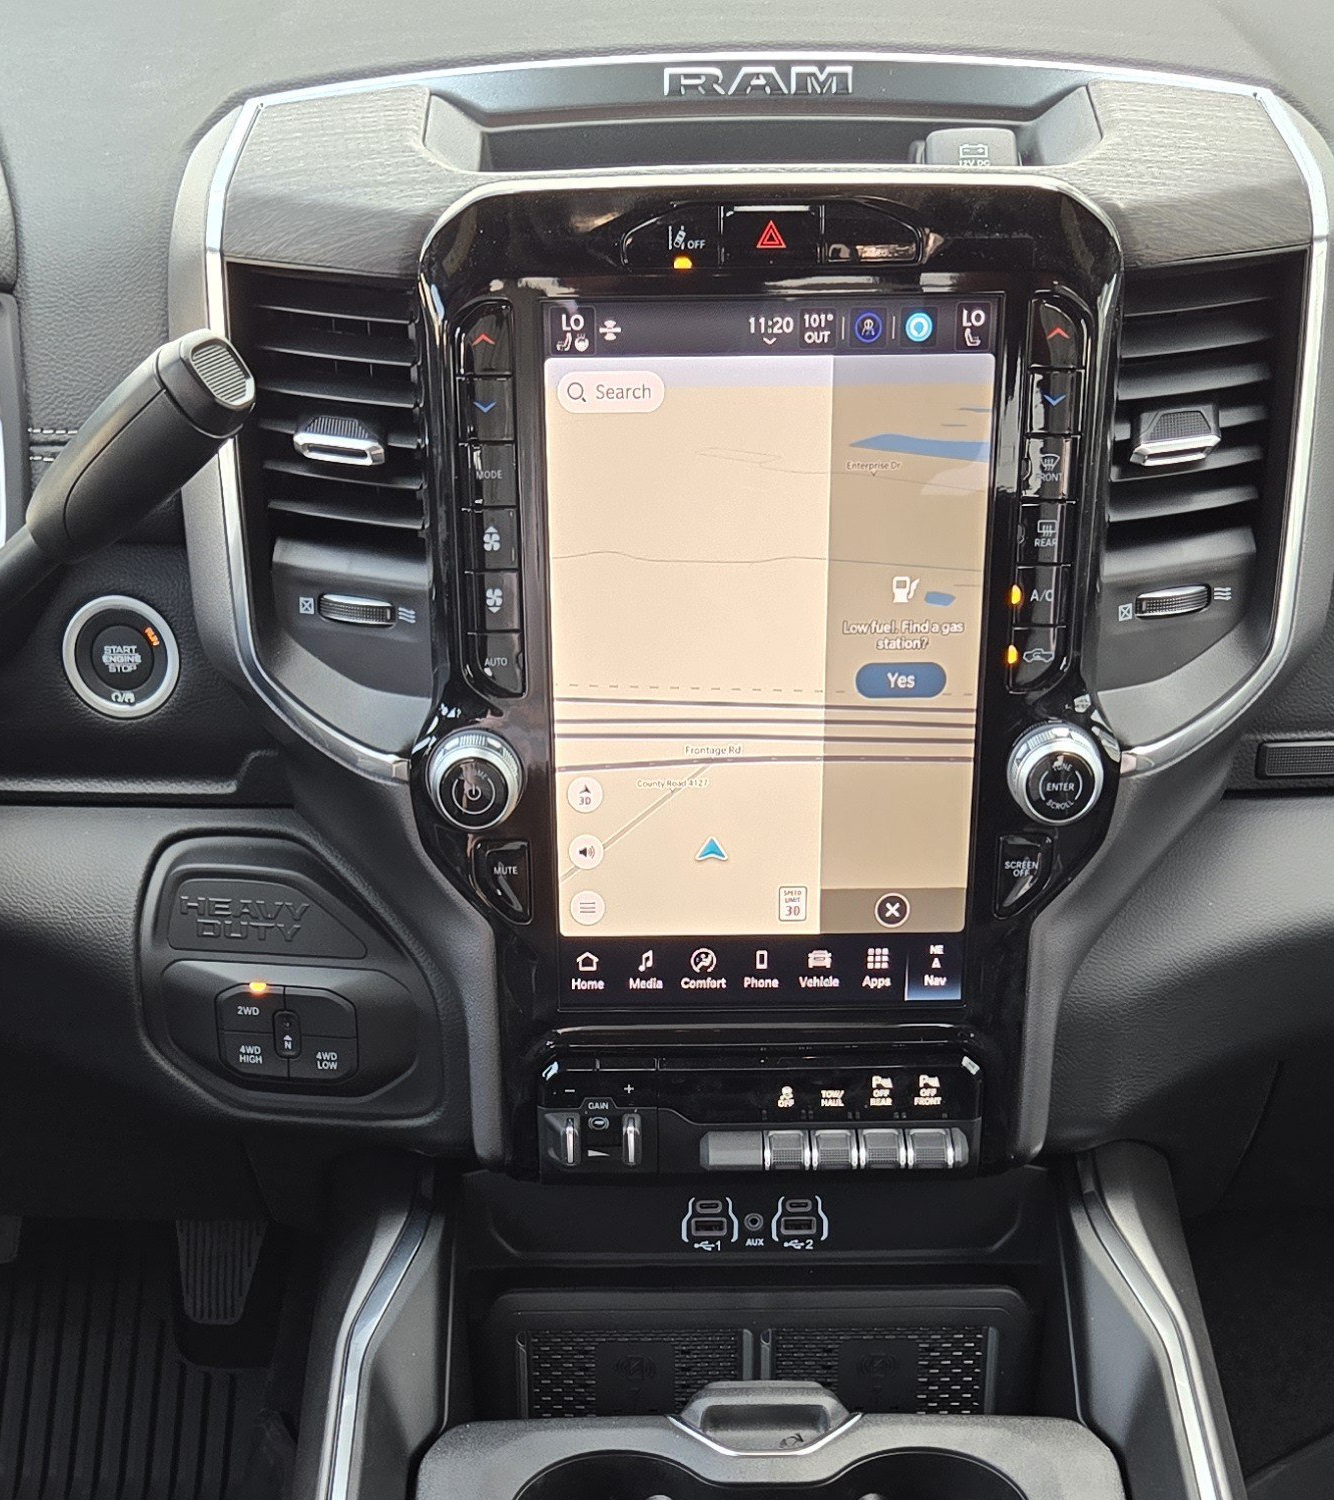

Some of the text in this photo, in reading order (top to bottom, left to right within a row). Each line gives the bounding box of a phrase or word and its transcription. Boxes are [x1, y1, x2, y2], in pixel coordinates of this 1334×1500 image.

[663, 66, 854, 96] RAM
[687, 239, 706, 250] OFF
[561, 314, 584, 331] LO
[961, 309, 985, 327] LO
[748, 316, 794, 334] 11:20
[803, 331, 830, 344] OUT
[595, 383, 652, 402] Search
[846, 460, 890, 471] Enterprise
[476, 470, 503, 480] MODE
[1034, 538, 1058, 547] REAR
[1030, 589, 1054, 602] A/C
[842, 619, 965, 636] Low fuel. Find a gas
[876, 637, 929, 650] station?
[104, 645, 138, 654] START
[101, 654, 142, 664] ENGINE
[483, 656, 508, 666] AUTO
[108, 664, 138, 673] STOP
[886, 672, 916, 689] Yes
[685, 746, 742, 756] Frontage Rd
[636, 780, 665, 789] County
[1046, 782, 1075, 791] ENTER
[579, 796, 592, 806] 3D
[1046, 799, 1075, 810] SCROLL
[1005, 860, 1039, 871] SCREEN
[493, 866, 518, 876] MUTE
[1013, 868, 1030, 878] OFF
[180, 895, 310, 921] HEAVY
[785, 905, 801, 917] 30
[197, 918, 301, 942] DUTY
[930, 945, 944, 955] NE
[571, 978, 605, 991] Home
[629, 977, 664, 990] Media
[680, 976, 727, 990] Comfort
[743, 976, 779, 989] Phone
[799, 975, 840, 988] Vehicle
[862, 975, 892, 990] Apps
[924, 974, 947, 987] Nav
[237, 1006, 260, 1016] 2WD
[239, 1045, 261, 1055] 4WD
[284, 1041, 292, 1050] N
[239, 1054, 263, 1064] HIGH
[316, 1052, 338, 1061] 4WD
[317, 1061, 338, 1070] LOW
[873, 1088, 890, 1097] OFF
[920, 1088, 937, 1097] OFF
[588, 1102, 609, 1110] GAIN
[777, 1098, 795, 1107] OFF
[820, 1098, 845, 1107] HAUL
[870, 1097, 893, 1106] REAR
[914, 1096, 942, 1106] FRONT
[714, 1240, 723, 1252] 1
[745, 1238, 765, 1248] AUX
[805, 1239, 814, 1251] 2
